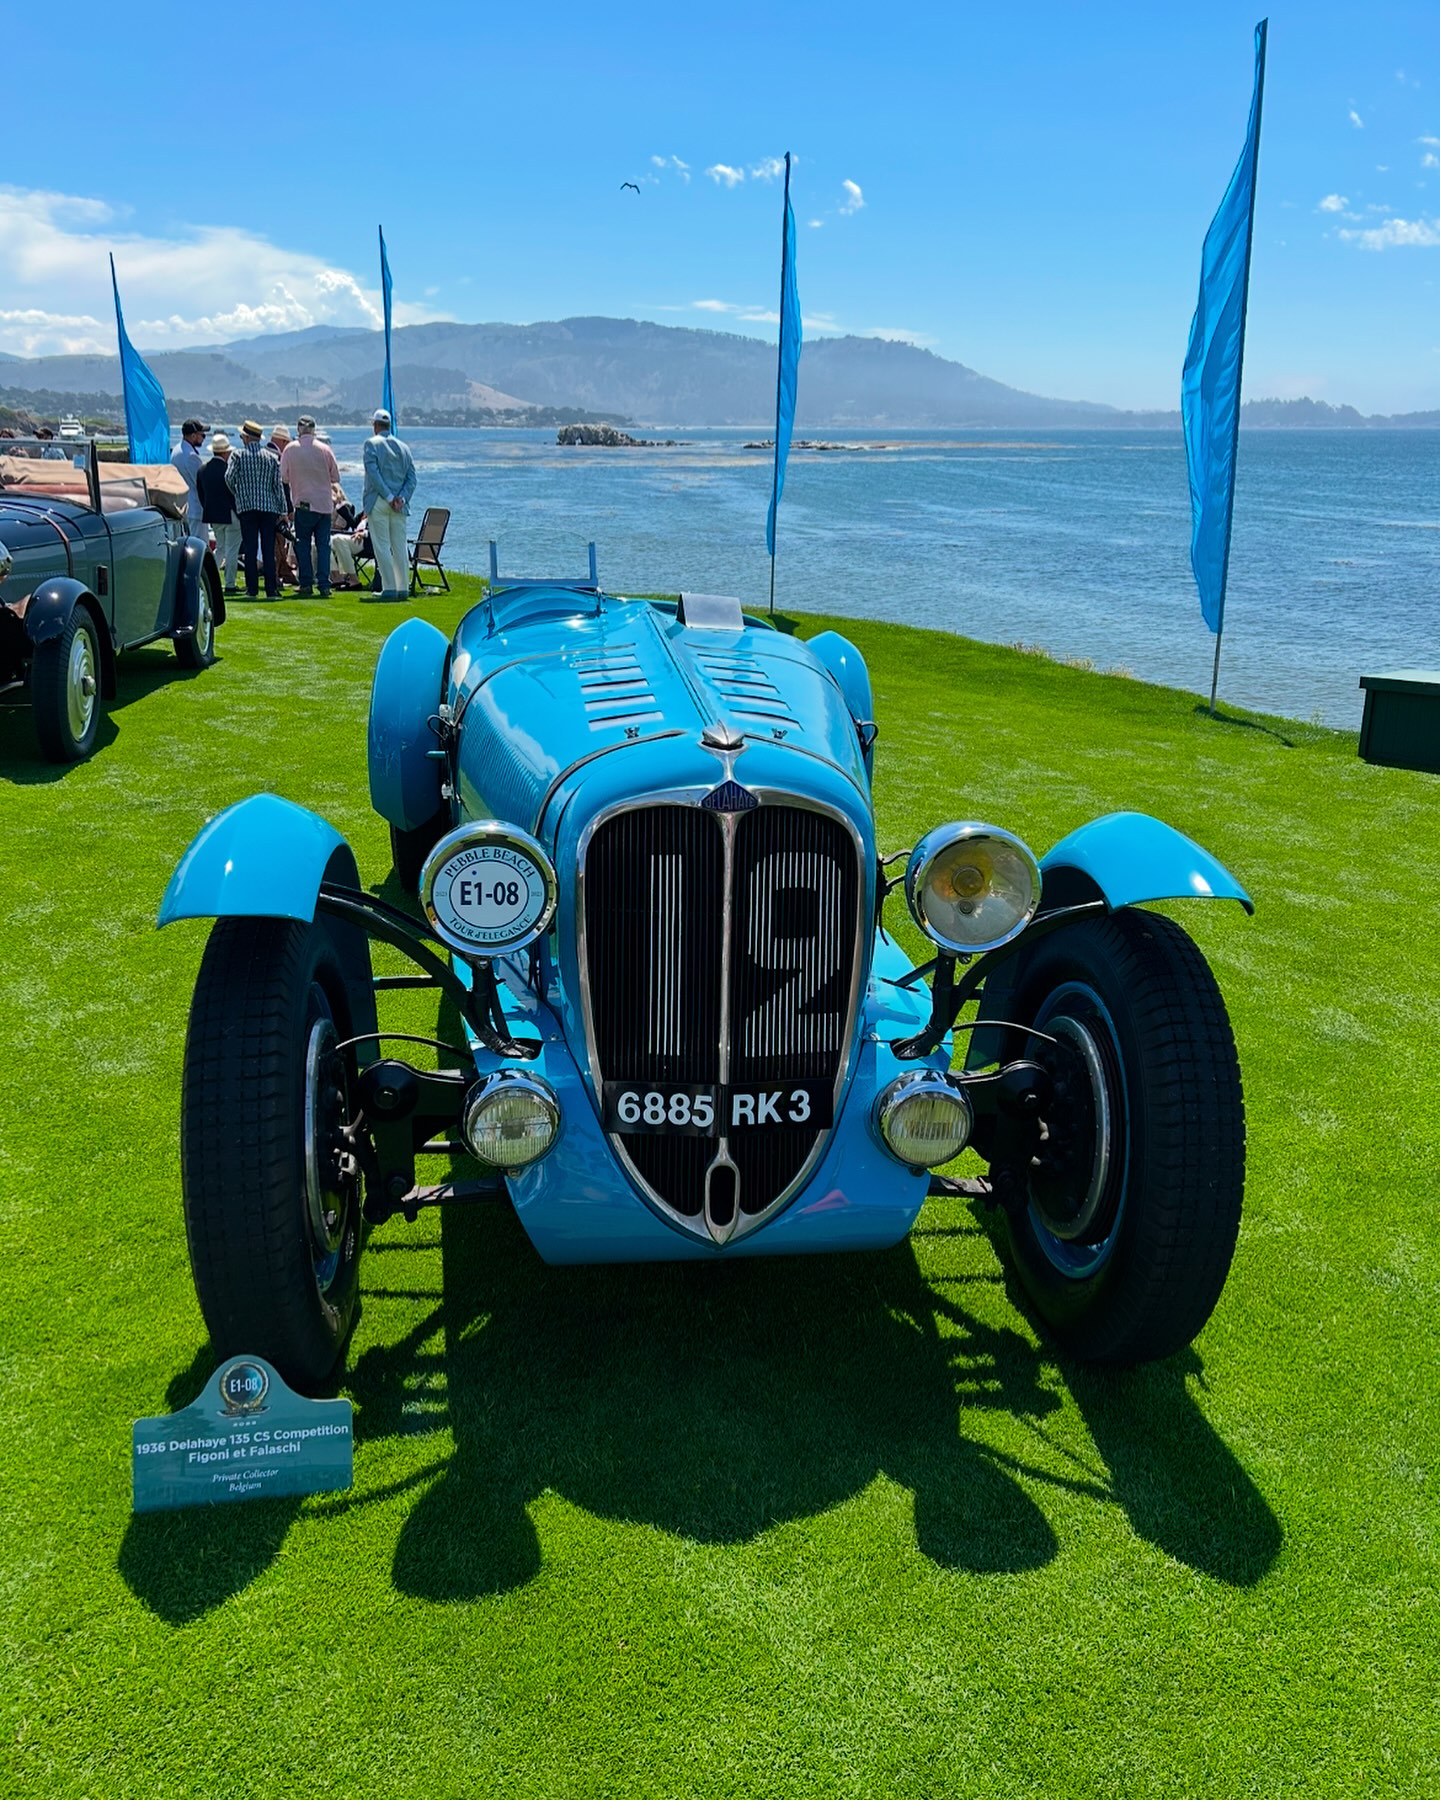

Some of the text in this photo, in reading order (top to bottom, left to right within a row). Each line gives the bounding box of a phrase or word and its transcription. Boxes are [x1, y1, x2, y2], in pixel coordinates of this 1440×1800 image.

[705, 783, 754, 810] DELAHAYE
[444, 848, 535, 878] PEBBLE BEACH
[460, 881, 519, 905] E1-08
[449, 917, 476, 937] TOUR
[617, 1089, 811, 1128] 6885 RK 3
[231, 1377, 258, 1393] E1-08
[136, 1424, 349, 1455] 1936 Delahaye 135 CS Competition
[188, 1442, 301, 1465] Figoni et Falaschi
[212, 1468, 279, 1484] Private Collector
[229, 1482, 262, 1493] Belgium
